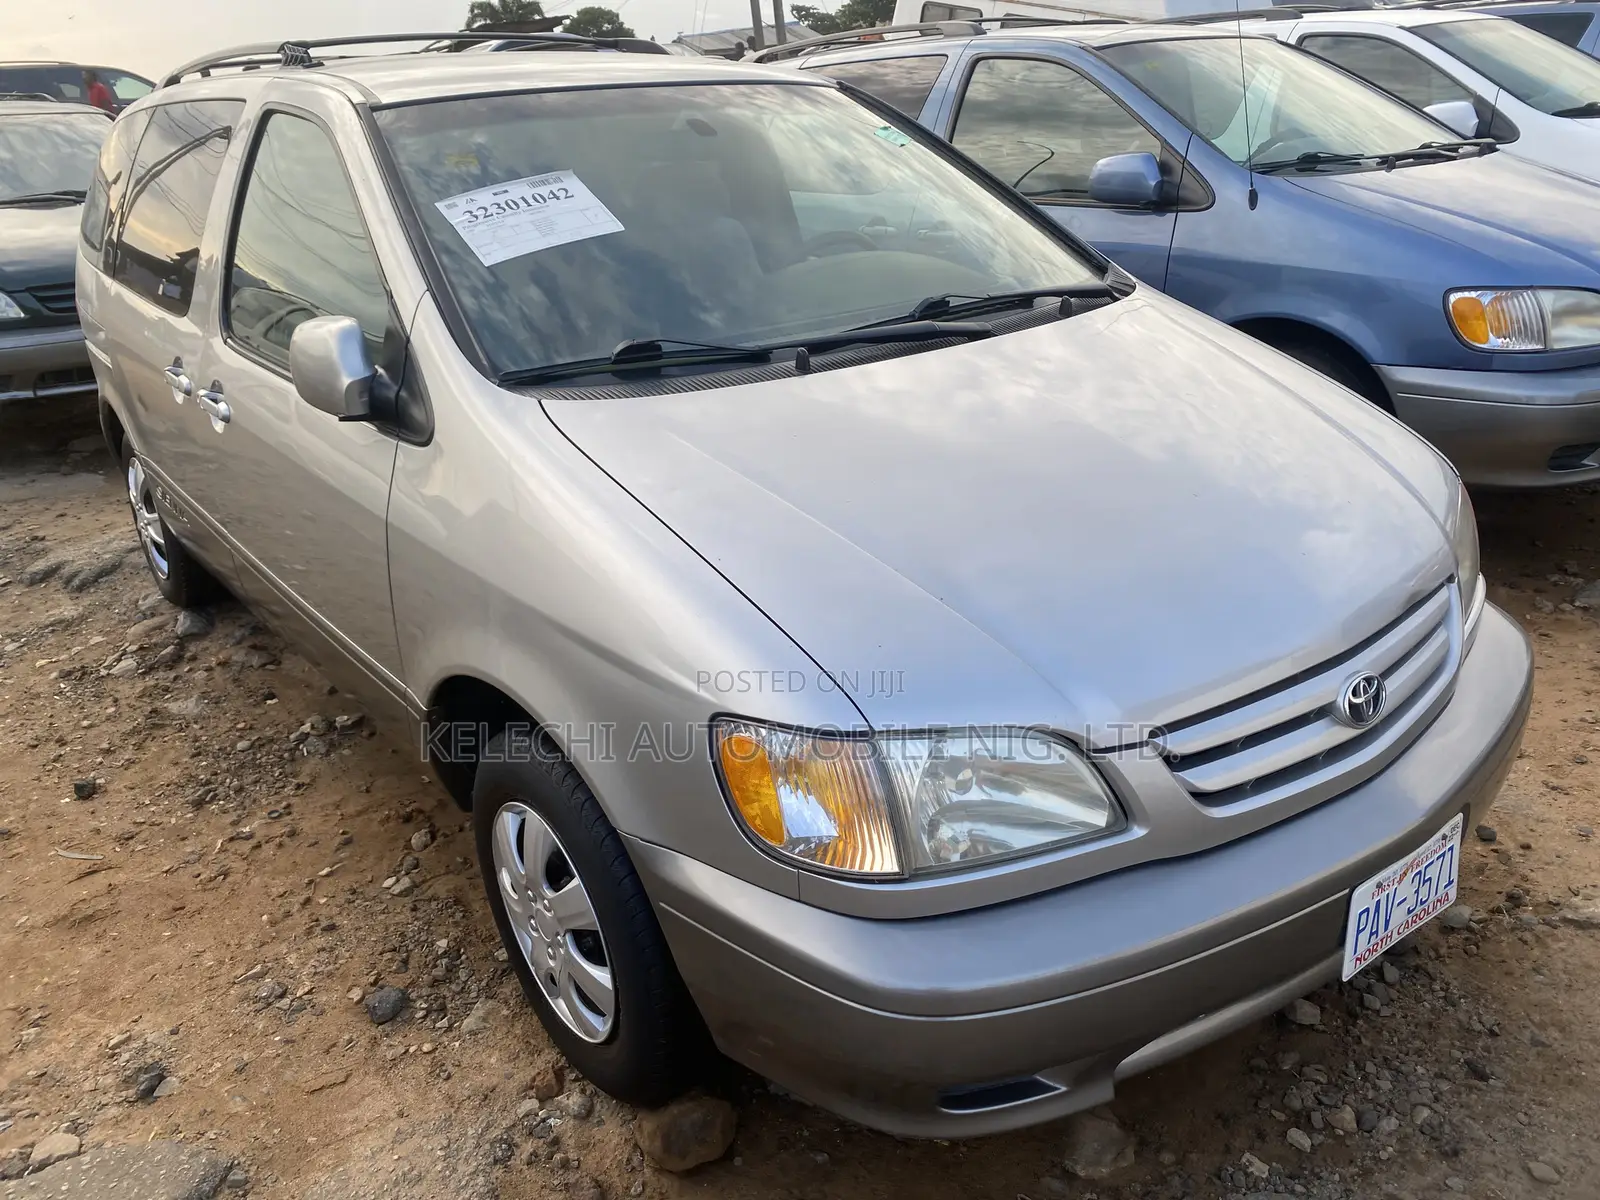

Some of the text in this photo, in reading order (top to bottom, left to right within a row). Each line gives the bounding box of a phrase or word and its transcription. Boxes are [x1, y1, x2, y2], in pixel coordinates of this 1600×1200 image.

[462, 187, 575, 223] 32301042
[1353, 843, 1455, 956] PAV-3571
[1371, 876, 1398, 900] FIRST
[1409, 839, 1448, 873] FREEDOM
[1354, 891, 1451, 970] NORTH CAROLINA
